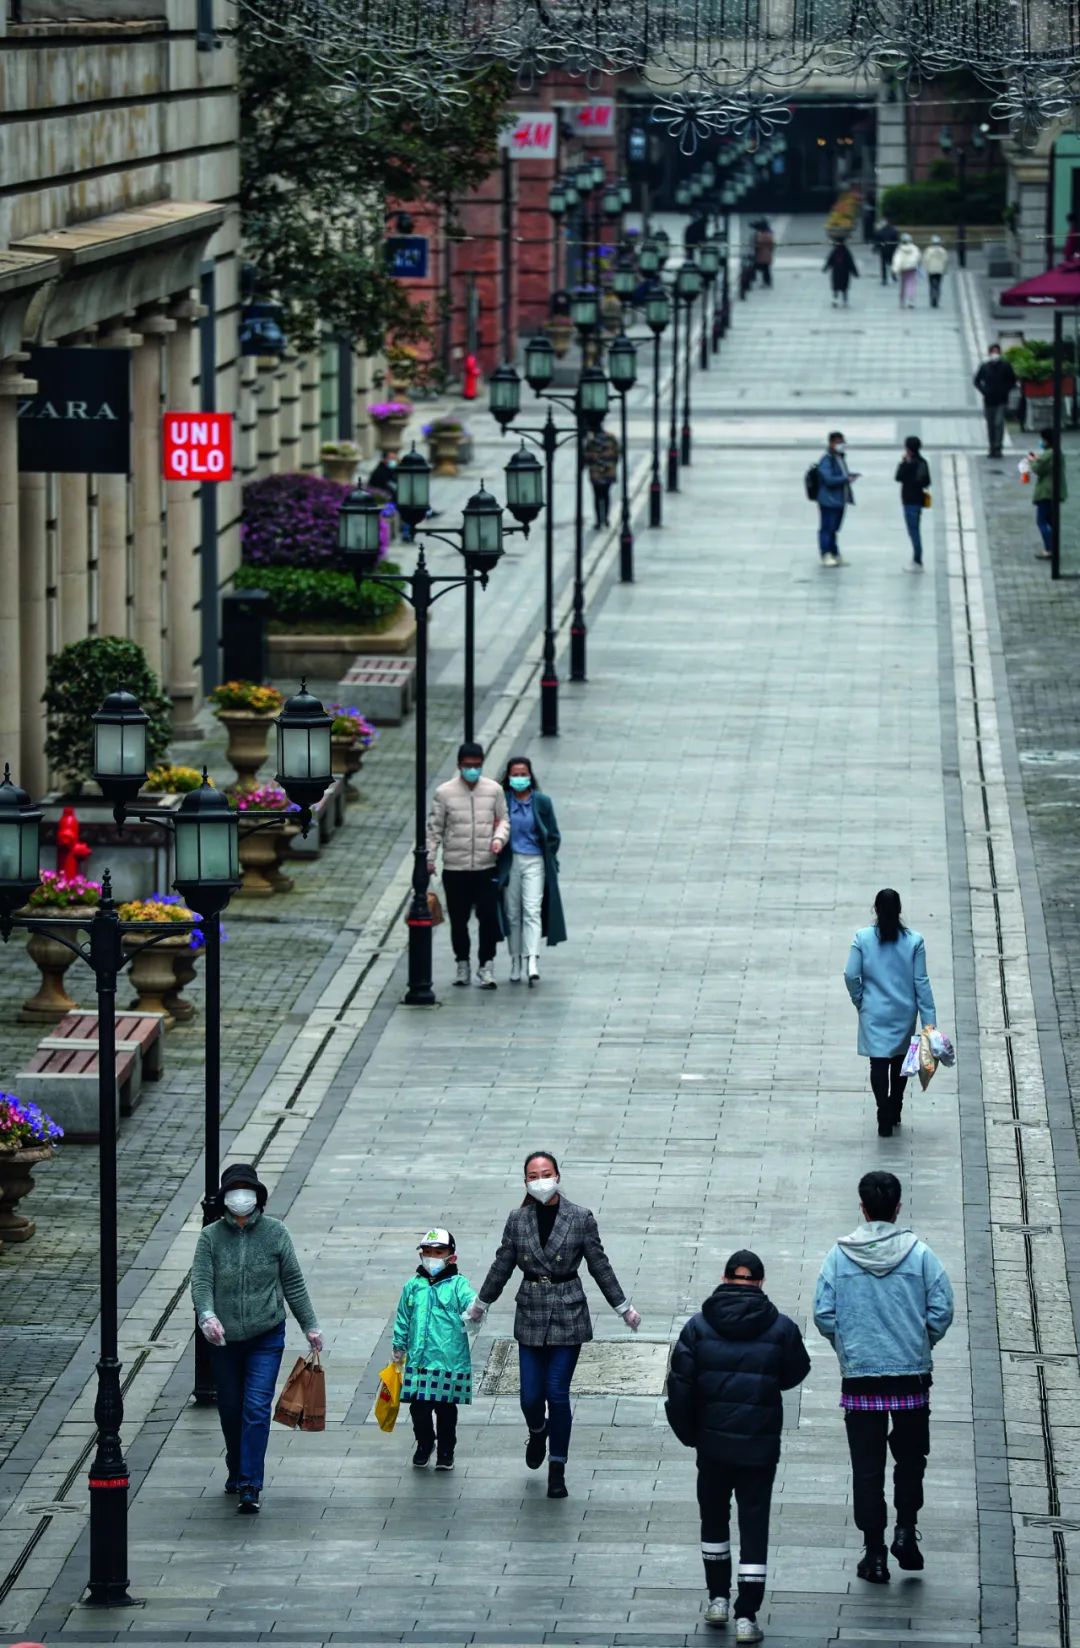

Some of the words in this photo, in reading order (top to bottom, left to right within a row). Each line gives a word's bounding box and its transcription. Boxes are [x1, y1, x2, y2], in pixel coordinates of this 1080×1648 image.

[17, 401, 119, 420] ZARA
[171, 422, 219, 445] UNI
[171, 449, 225, 476] QLO
